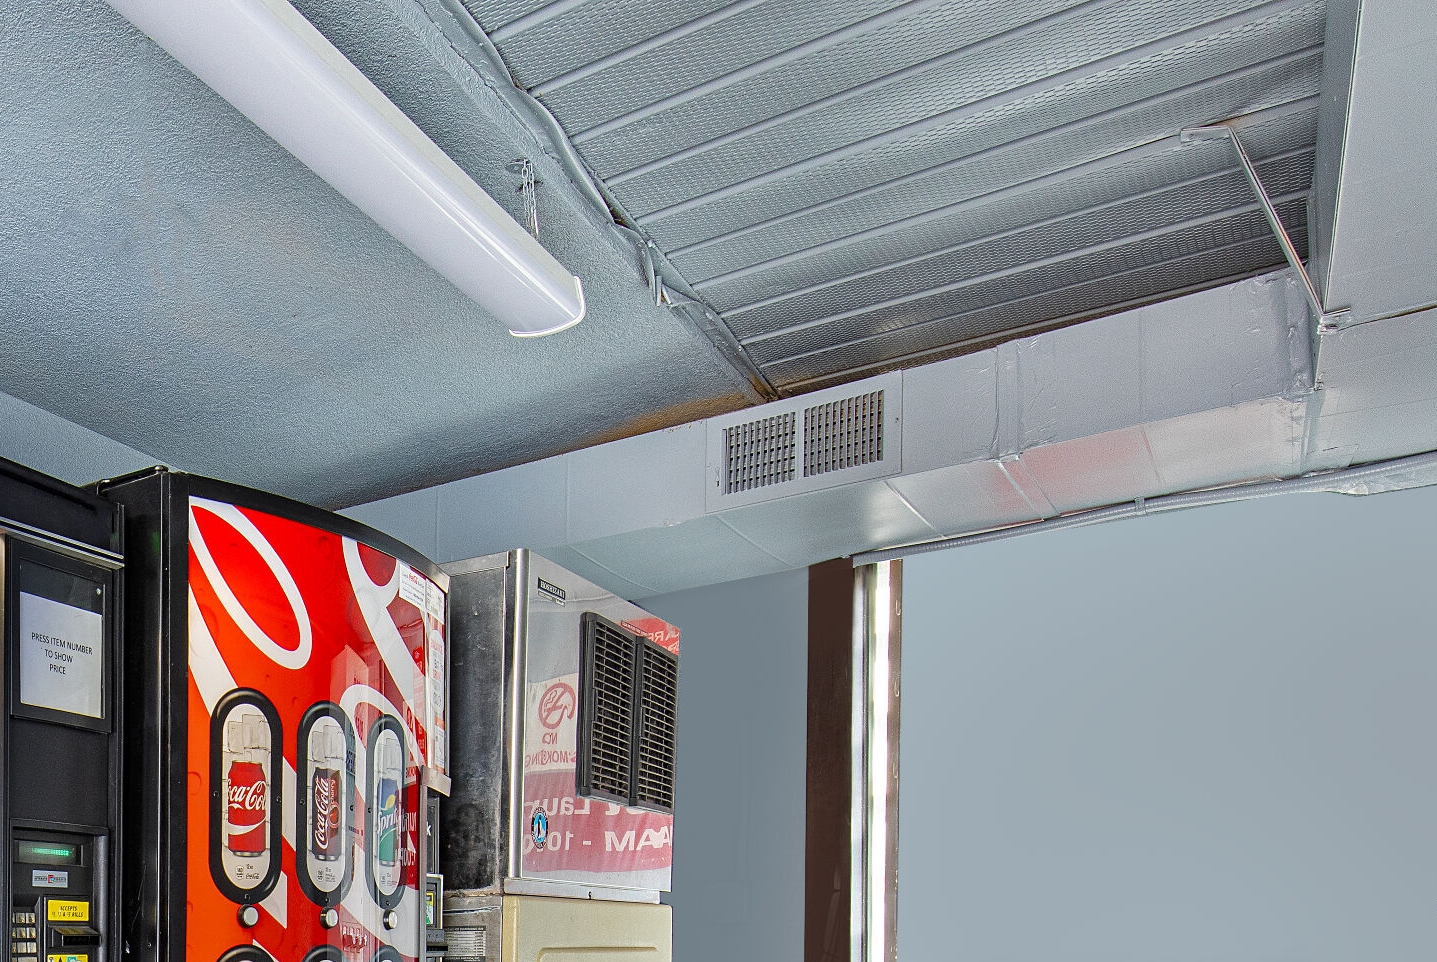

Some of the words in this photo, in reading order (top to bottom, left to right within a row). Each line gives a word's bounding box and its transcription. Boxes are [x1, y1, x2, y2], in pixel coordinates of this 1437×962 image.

[31, 632, 50, 644] PRESS
[50, 637, 66, 648] ITEM
[66, 641, 93, 655] NUMBER
[45, 649, 54, 658] TO
[54, 651, 74, 663] SHOW
[49, 663, 66, 675] PRICE
